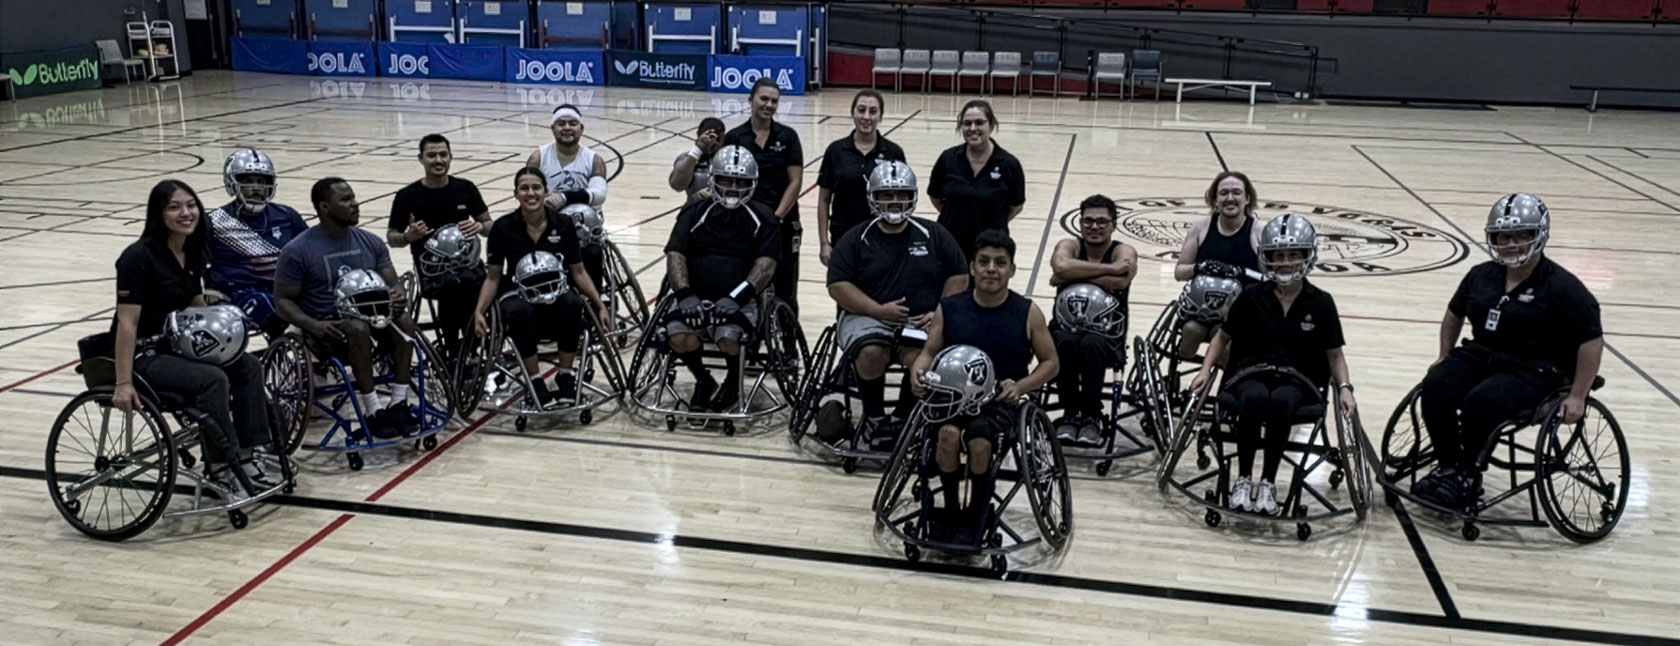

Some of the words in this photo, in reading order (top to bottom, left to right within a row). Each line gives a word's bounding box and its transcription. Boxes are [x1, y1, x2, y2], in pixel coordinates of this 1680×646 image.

[39, 58, 99, 84] Butterfly
[516, 58, 594, 83] JOOLA
[639, 60, 695, 80] Butterfly
